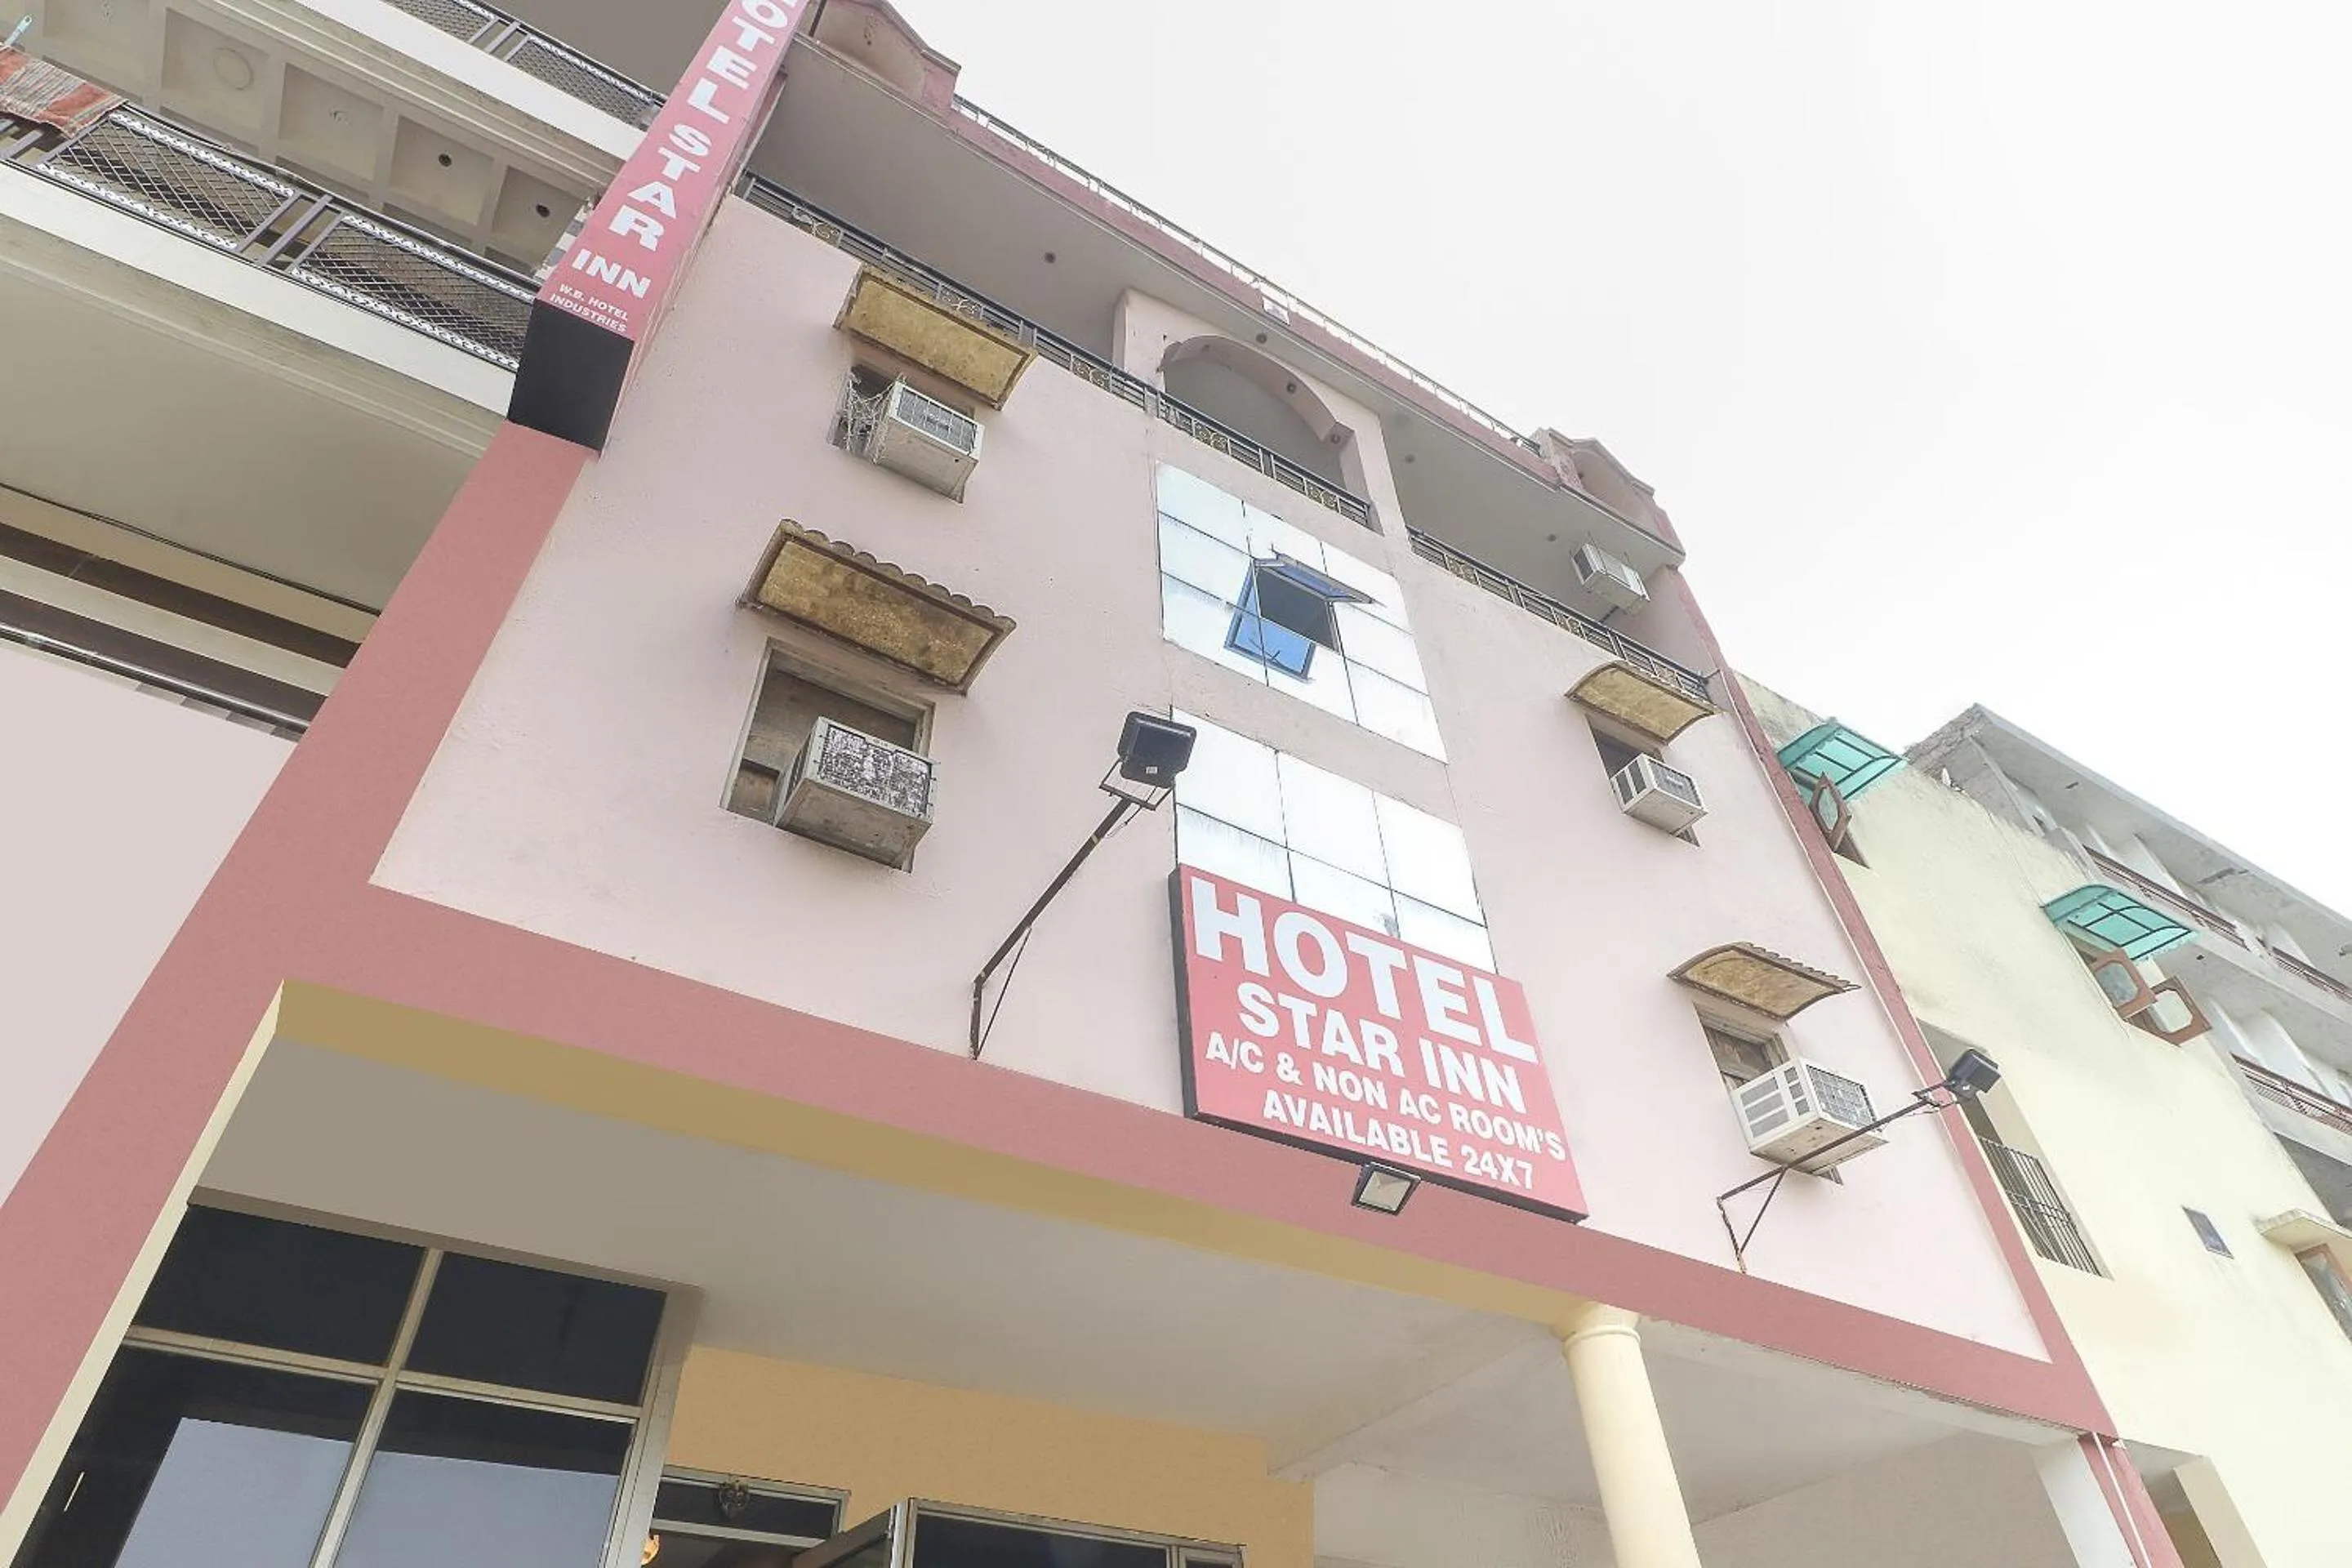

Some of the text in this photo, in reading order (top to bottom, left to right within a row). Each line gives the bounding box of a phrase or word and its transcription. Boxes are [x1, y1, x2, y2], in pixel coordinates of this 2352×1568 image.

[608, 0, 797, 252] OTEL STAR
[550, 293, 627, 332] INDUSTRIES
[572, 248, 652, 299] INN
[588, 296, 628, 321] HOTEL
[1191, 876, 1539, 1064] HOTEL
[1205, 1031, 1566, 1161] A/C & NON AC ROOM'S
[1236, 982, 1526, 1114] STAR INN
[1263, 1090, 1534, 1189] AVAILABLE 24X7
